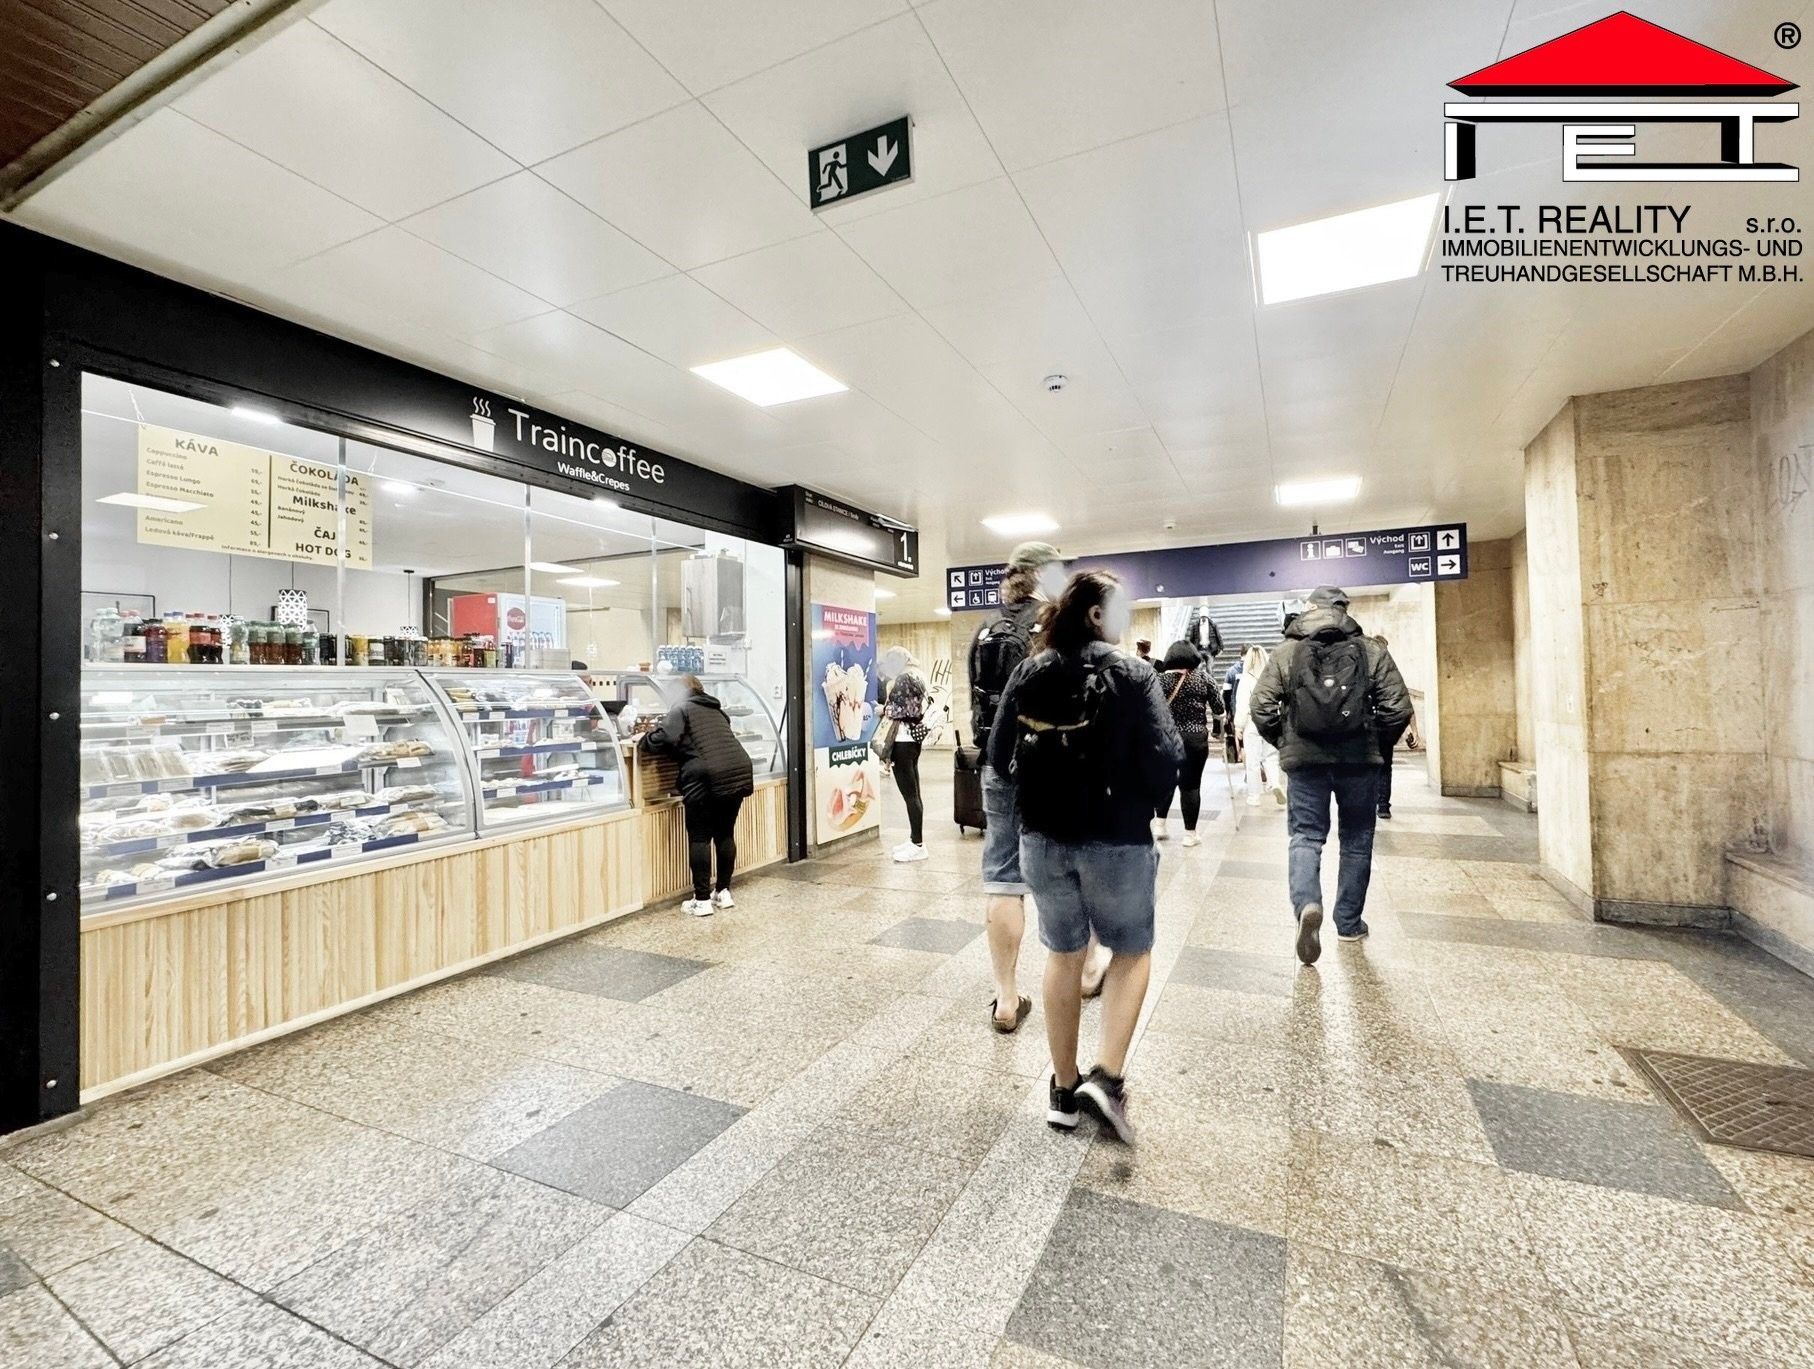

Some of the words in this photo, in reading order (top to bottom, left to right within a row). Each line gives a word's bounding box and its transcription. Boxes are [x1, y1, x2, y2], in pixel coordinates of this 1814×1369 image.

[175, 438, 219, 457] KÁVA
[507, 407, 665, 484] Traincoffee
[179, 475, 201, 485] Lungo
[290, 460, 359, 486] ČOKOLDA
[557, 461, 630, 491] Waffle&Crepes
[179, 484, 214, 498] Macchiato
[314, 526, 336, 541] ČAJ
[1370, 534, 1404, 545] Východ
[296, 542, 322, 554] HOT
[1411, 562, 1429, 572] WC
[823, 610, 867, 627] MILKSHAKE
[831, 745, 867, 762] CHLEBÍČKY
